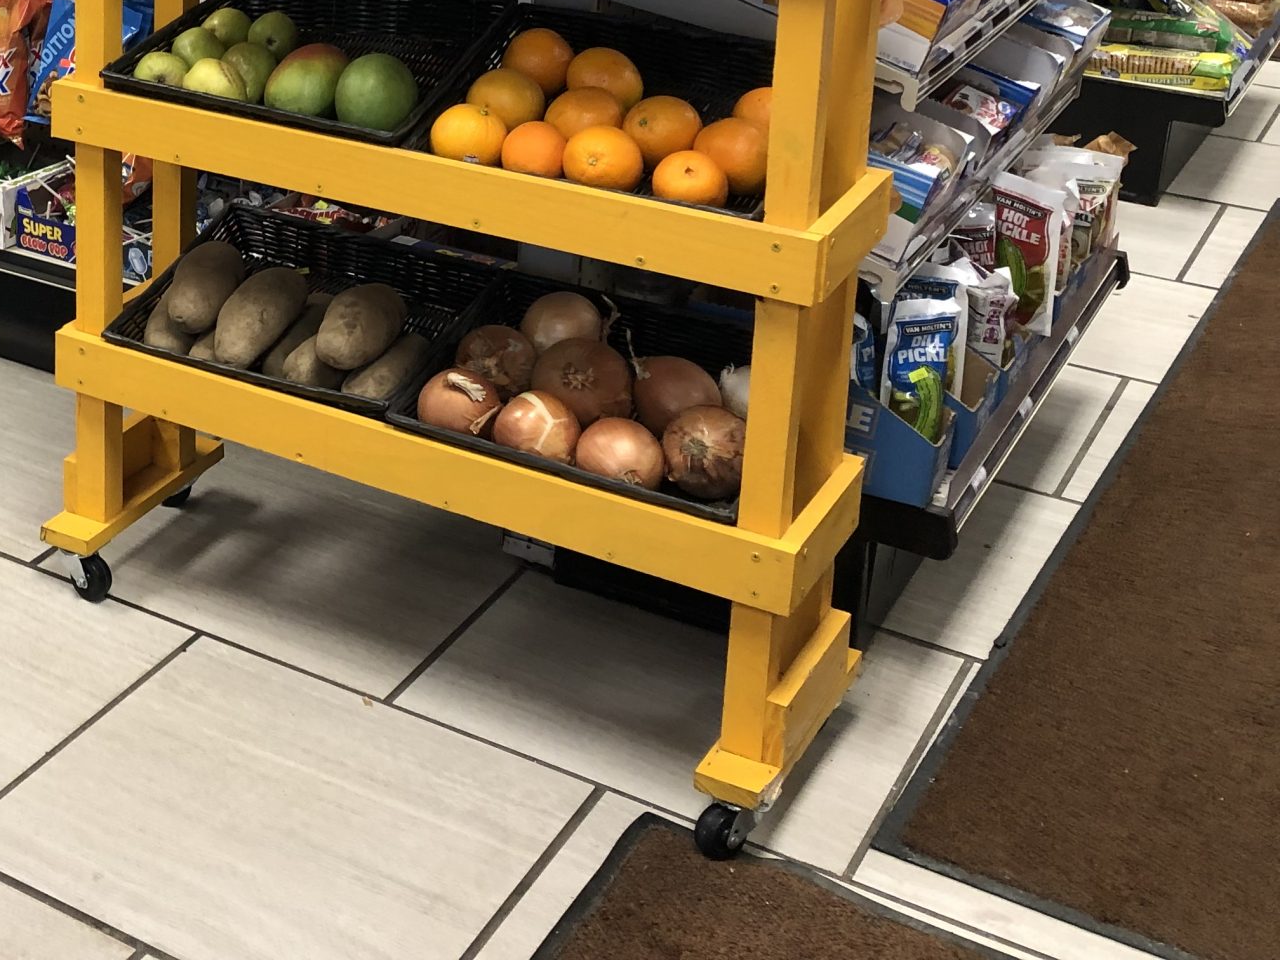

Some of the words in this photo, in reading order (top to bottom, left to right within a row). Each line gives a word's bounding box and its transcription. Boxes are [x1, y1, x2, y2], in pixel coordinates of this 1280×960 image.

[996, 195, 1013, 205] VAN
[1002, 207, 1030, 227] HOT
[22, 218, 62, 242] SUPER
[21, 236, 46, 253] BLOW
[48, 242, 68, 258] POP
[920, 323, 952, 333] HOLTEN'S
